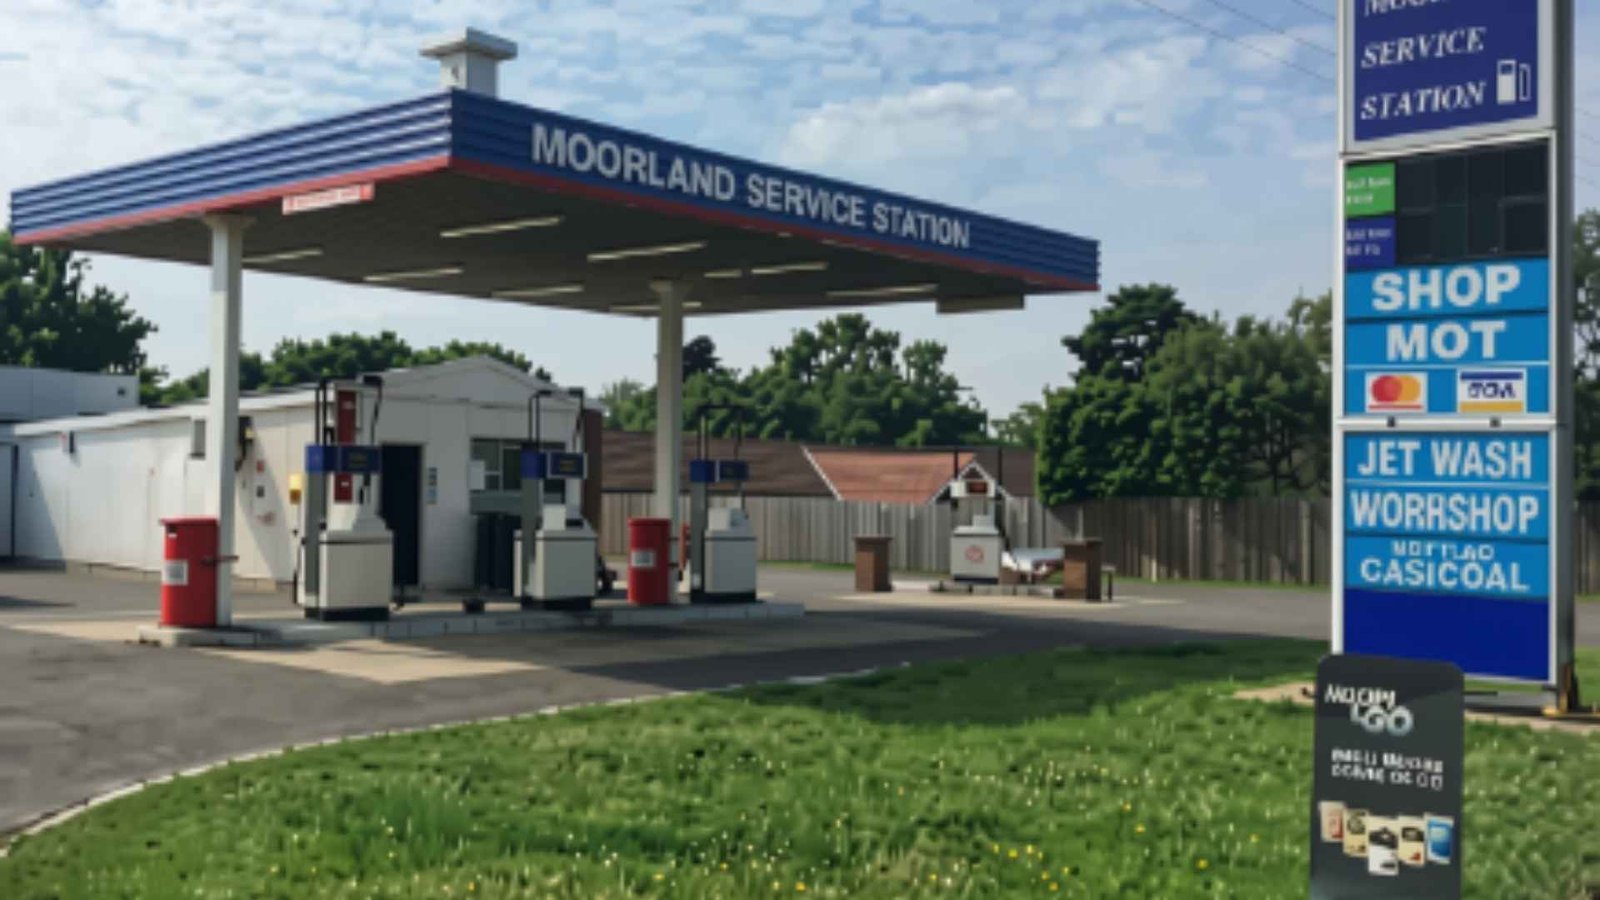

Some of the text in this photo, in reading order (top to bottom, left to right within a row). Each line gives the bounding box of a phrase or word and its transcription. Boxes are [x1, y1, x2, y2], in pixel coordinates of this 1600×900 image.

[1361, 27, 1487, 68] SERVICE
[1361, 80, 1487, 120] STATION
[531, 122, 970, 248] MOORLAND SERVICE STATION
[1371, 264, 1521, 311] SHOP
[1386, 321, 1507, 361] MOT
[1357, 441, 1532, 479] JET WASH
